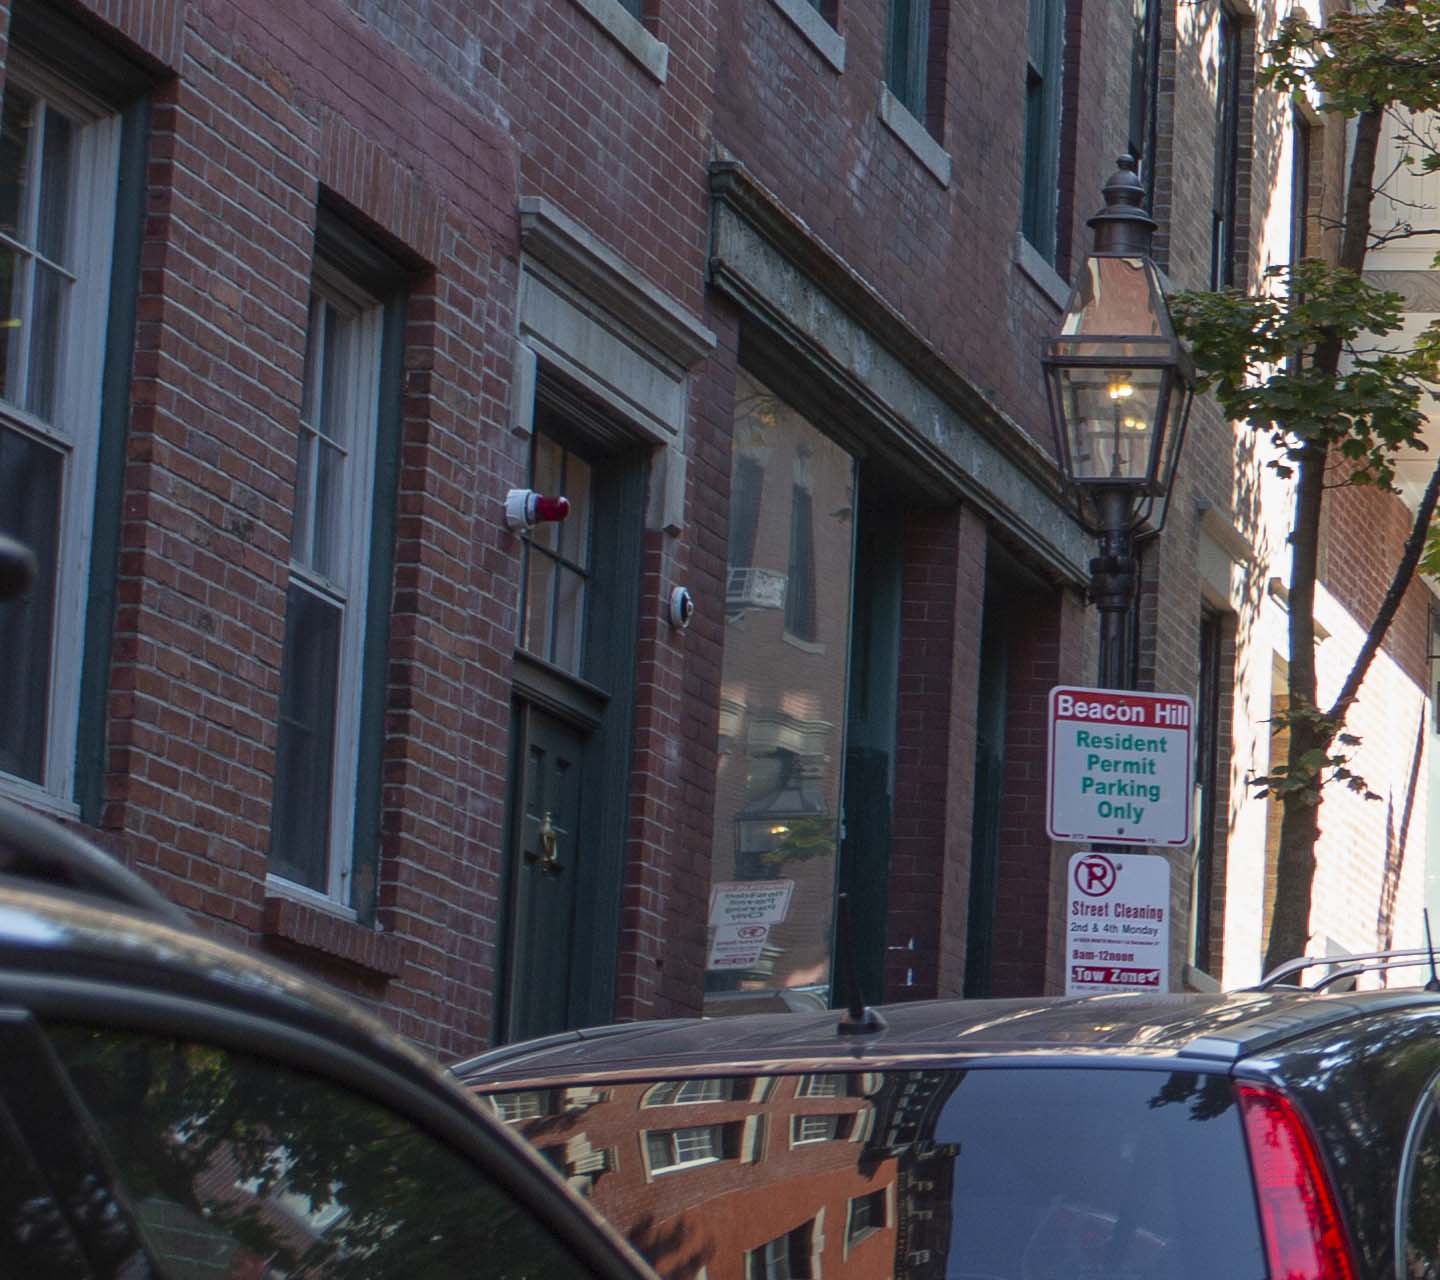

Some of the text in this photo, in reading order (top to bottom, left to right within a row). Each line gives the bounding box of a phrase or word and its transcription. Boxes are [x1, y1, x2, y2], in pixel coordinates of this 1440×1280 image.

[1057, 694, 1189, 726] Beacon Hill
[1075, 730, 1168, 753] Resident
[1087, 753, 1156, 775] Permit
[1081, 776, 1161, 802] Parking
[1097, 800, 1145, 825] Only
[1072, 900, 1164, 922] Street Cleaning
[1070, 922, 1159, 937] 2nd & 4th Monday
[1075, 967, 1148, 983] Tow Zone
